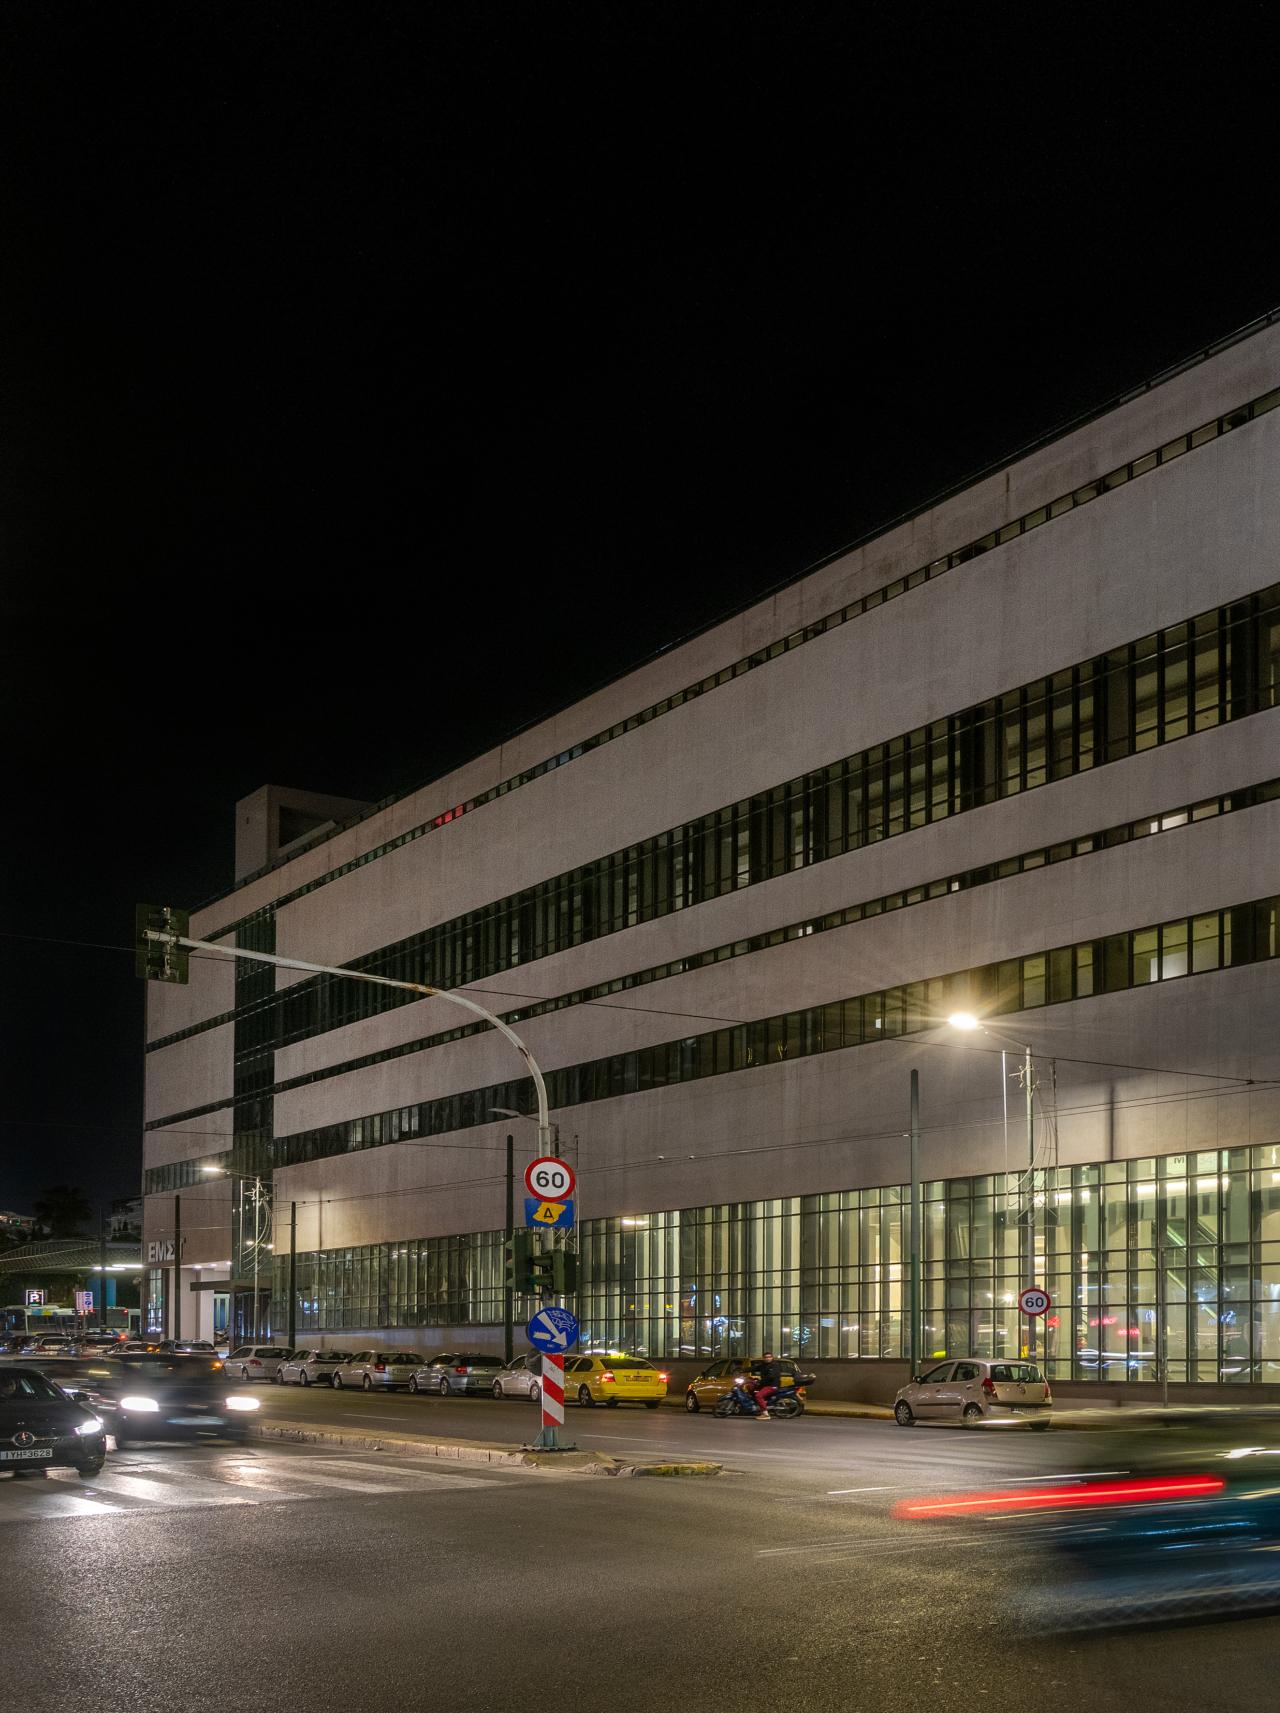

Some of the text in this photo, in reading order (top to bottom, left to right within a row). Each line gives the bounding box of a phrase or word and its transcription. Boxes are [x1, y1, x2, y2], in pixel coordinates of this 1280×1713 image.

[536, 1170, 565, 1189] 60
[148, 1239, 184, 1262] ΕΜΣ
[1025, 1297, 1044, 1308] 60
